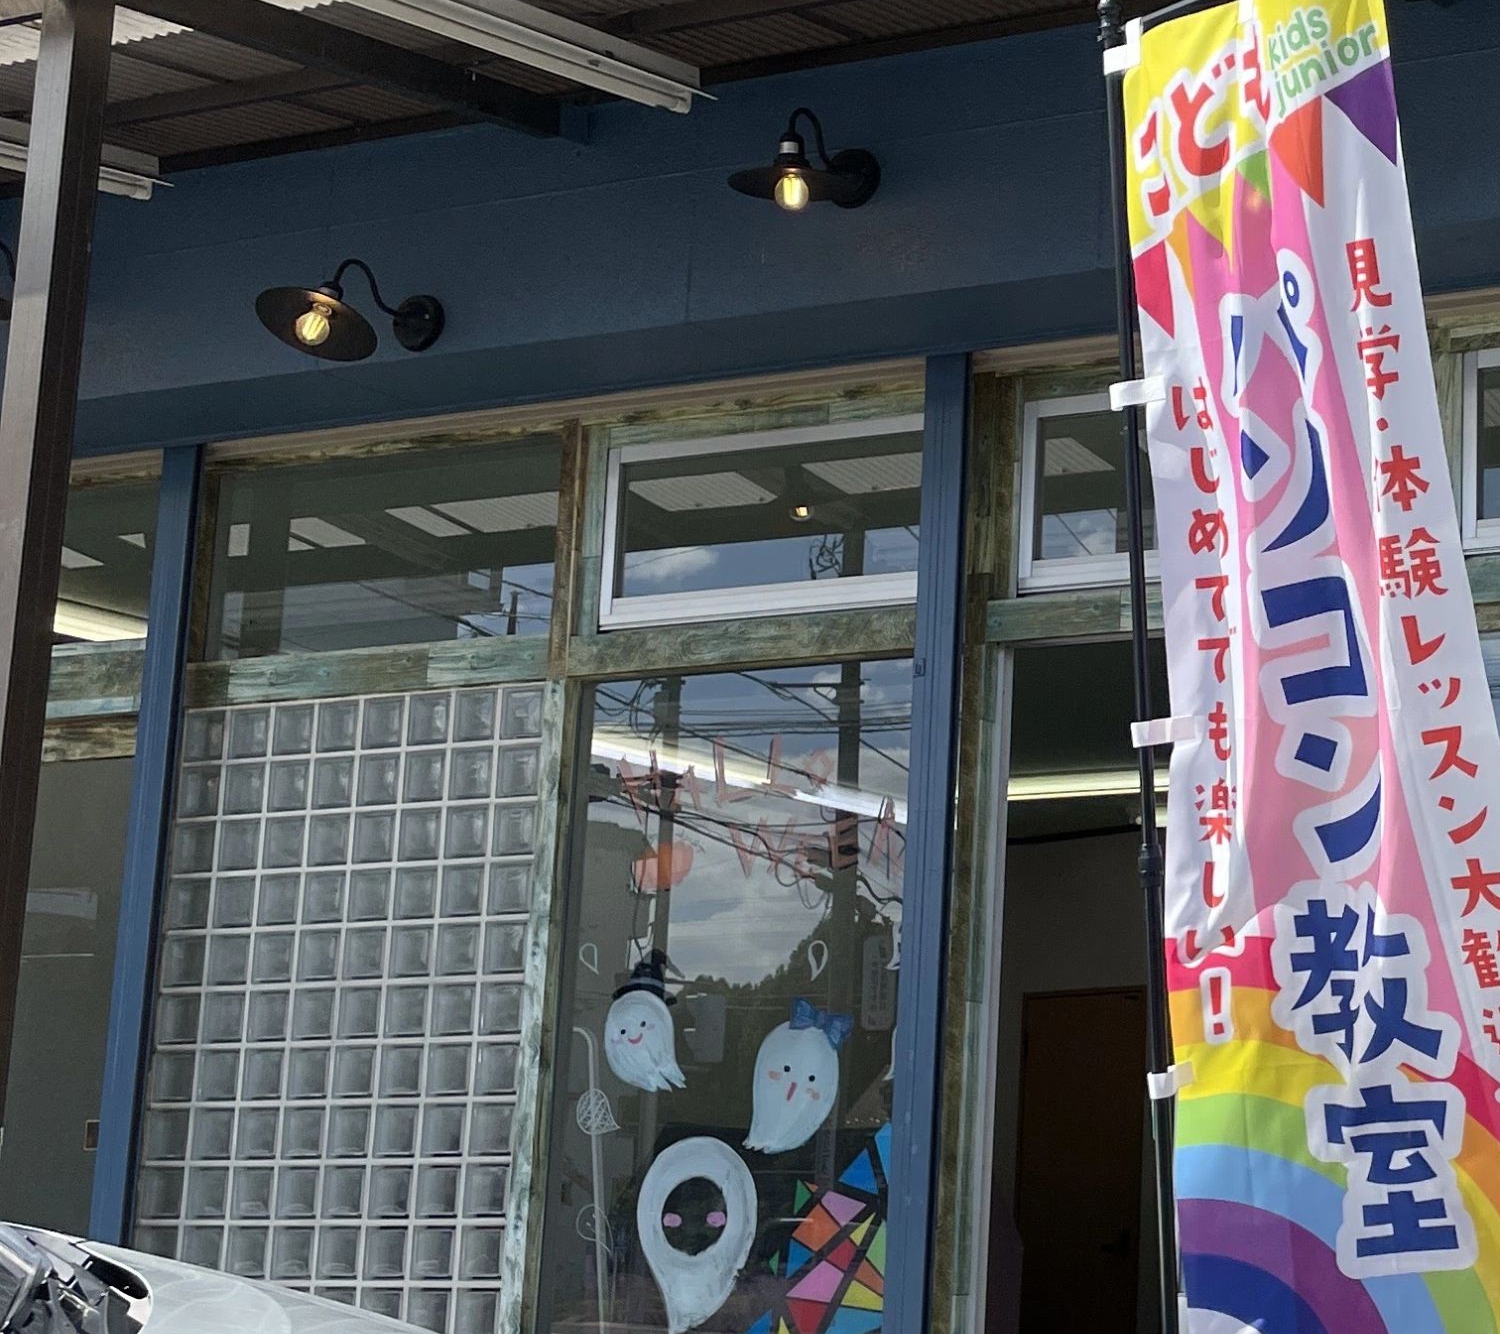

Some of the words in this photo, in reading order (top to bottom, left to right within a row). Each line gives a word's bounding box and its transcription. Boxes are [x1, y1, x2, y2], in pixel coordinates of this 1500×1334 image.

[1268, 8, 1329, 64] kids
[1273, 24, 1376, 118] junior
[1231, 269, 1460, 1259] パソコン教室
